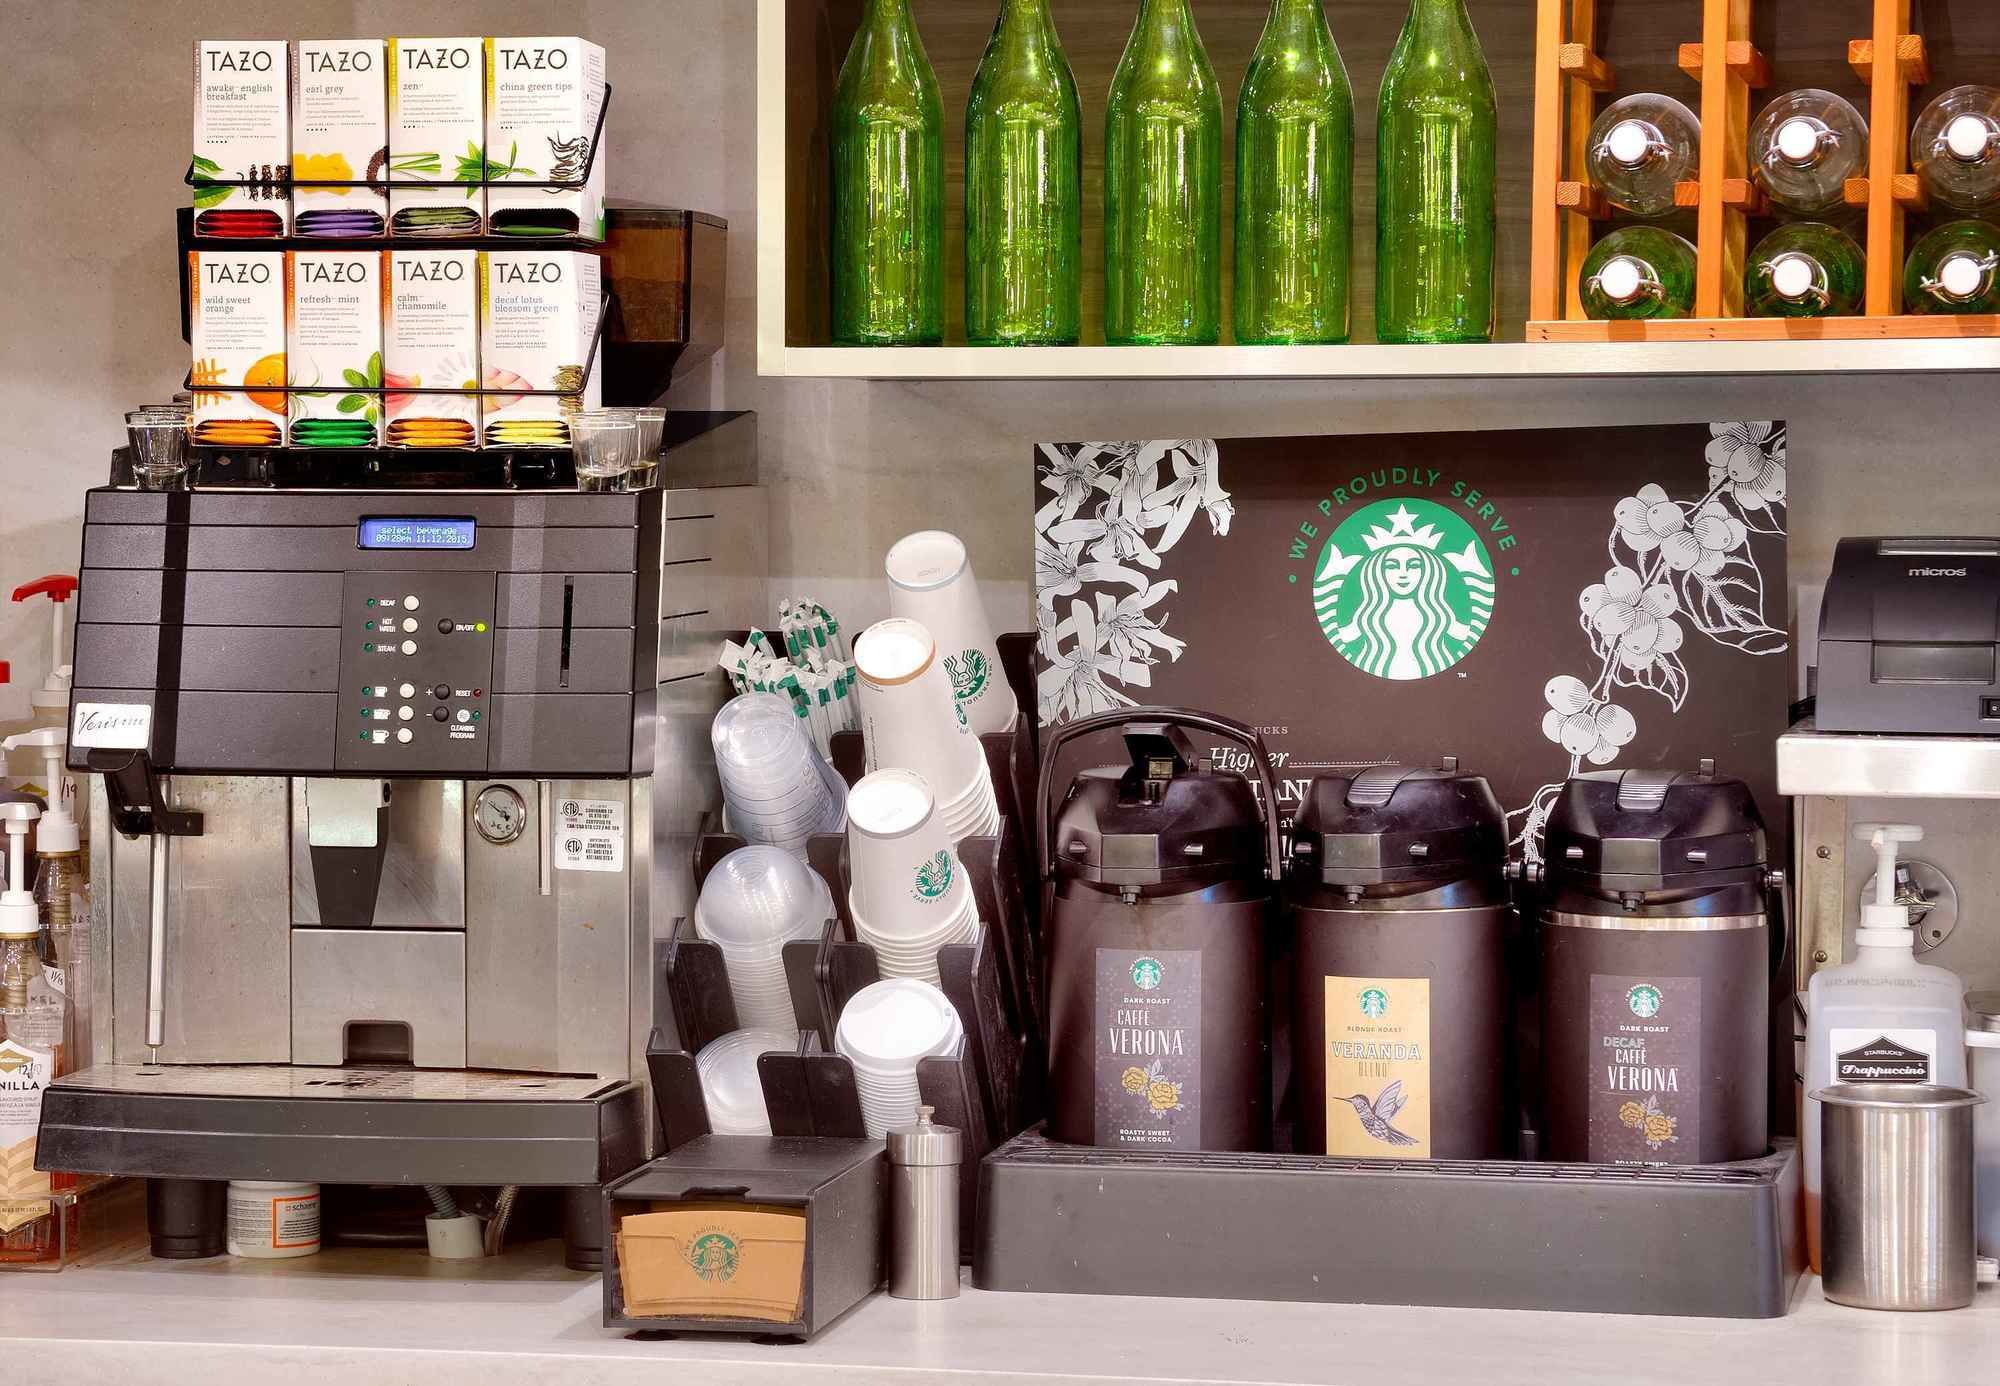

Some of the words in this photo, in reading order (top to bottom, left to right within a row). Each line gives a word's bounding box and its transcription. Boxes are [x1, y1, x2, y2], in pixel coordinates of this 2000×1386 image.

[206, 51, 272, 72] TAZO
[305, 51, 372, 72] TAZO
[403, 48, 470, 69] TAZO
[500, 48, 568, 70] TAZO
[240, 82, 273, 94] english
[306, 85, 323, 94] earl
[325, 86, 344, 96] grey
[403, 83, 419, 91] zen
[500, 82, 525, 91] china
[527, 83, 553, 93] green
[555, 82, 573, 93] tips
[206, 91, 247, 101] breakfast
[205, 263, 270, 284] TAZO
[300, 262, 366, 283] TAZO
[397, 260, 464, 281] TAZO
[494, 262, 562, 283] TAZO
[205, 296, 223, 304] wild
[226, 296, 251, 304] sweet
[300, 295, 331, 304] refresh
[338, 296, 359, 304] mint
[397, 293, 418, 302] calm
[494, 295, 518, 304] decaf
[520, 296, 543, 304] lotus
[205, 305, 234, 313] orange
[397, 302, 447, 310] chamomile
[494, 304, 532, 313] blossom
[533, 305, 559, 314] green
[1289, 520, 1318, 560] WE
[1318, 467, 1441, 517] PROUDLY
[1451, 480, 1518, 551] SERVE
[381, 526, 412, 535] select
[416, 526, 457, 535] beverage
[1909, 567, 1967, 577] micros
[456, 624, 475, 632] ON/OFF
[450, 724, 476, 732] CLEANING
[1210, 748, 1289, 773] Higer
[1109, 1027, 1184, 1055] VERONA
[1603, 1036, 1646, 1049] DECAF
[1331, 1041, 1422, 1061] VERANDA
[1358, 1061, 1387, 1078] BLEND
[1841, 1064, 1926, 1077] Frappuccino
[1607, 1065, 1679, 1092] VERONA
